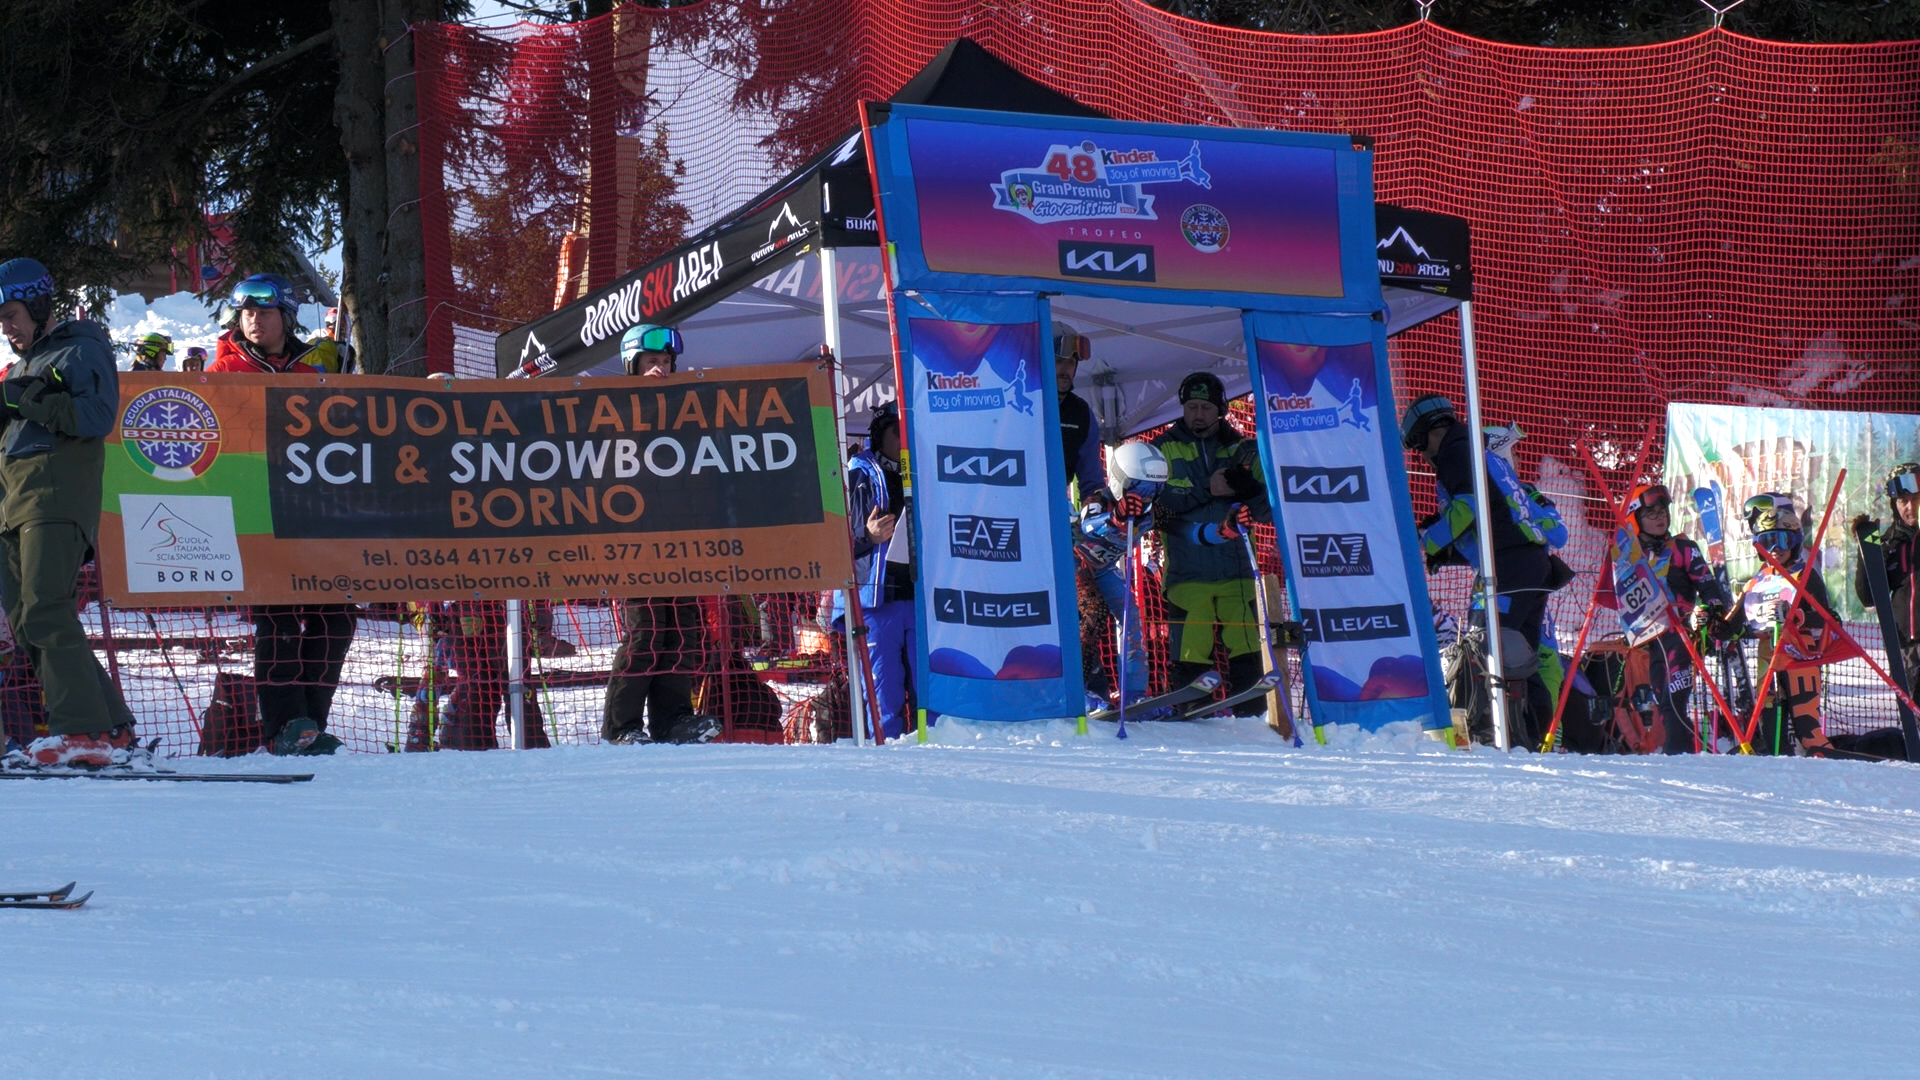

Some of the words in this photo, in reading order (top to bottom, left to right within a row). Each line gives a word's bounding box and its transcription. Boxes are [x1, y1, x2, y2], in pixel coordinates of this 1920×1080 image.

[1047, 153, 1097, 182] 48
[1109, 168, 1128, 181] Joy
[1129, 168, 1140, 178] of
[1142, 166, 1176, 178] moving
[1032, 181, 1111, 199] GranPremio
[1034, 200, 1118, 217] Giovanissimi
[1066, 249, 1147, 274] KIA
[581, 279, 642, 347] BORNO
[642, 262, 673, 317] SKI
[674, 241, 724, 302] AREA
[124, 392, 155, 426] SCUOLA
[157, 388, 204, 411] ITALIANA
[202, 409, 215, 428] SCI
[284, 394, 520, 436] SCUOLA
[541, 387, 795, 434] ITALIANA
[932, 395, 949, 410] Joy
[951, 394, 962, 407] of
[964, 393, 1000, 407] moving
[1272, 416, 1289, 430] Joy
[1290, 415, 1300, 425] of
[123, 429, 219, 441] BORNO
[286, 442, 372, 484] SCI
[395, 445, 429, 484] &
[450, 432, 797, 483] SNOWBOARD
[944, 455, 1018, 478] KIA
[1288, 474, 1360, 495] KIA
[451, 484, 645, 528] BORNO
[951, 517, 1016, 549] EA7
[173, 544, 211, 552] ITALIANA
[362, 549, 398, 566] tel.
[405, 549, 460, 566] 0364
[467, 547, 533, 565] 41769
[547, 545, 595, 563] cell.
[604, 544, 642, 561] 377
[652, 539, 744, 560] 1211308
[1300, 536, 1364, 565] EA7
[157, 570, 233, 583] BORNO
[291, 571, 550, 592] info@scuolasciborno.it
[563, 561, 822, 587] www.scuolasciborno.it
[1626, 582, 1651, 610] 621
[972, 602, 1040, 618] LEVEL
[1330, 615, 1399, 632] LEVEL
